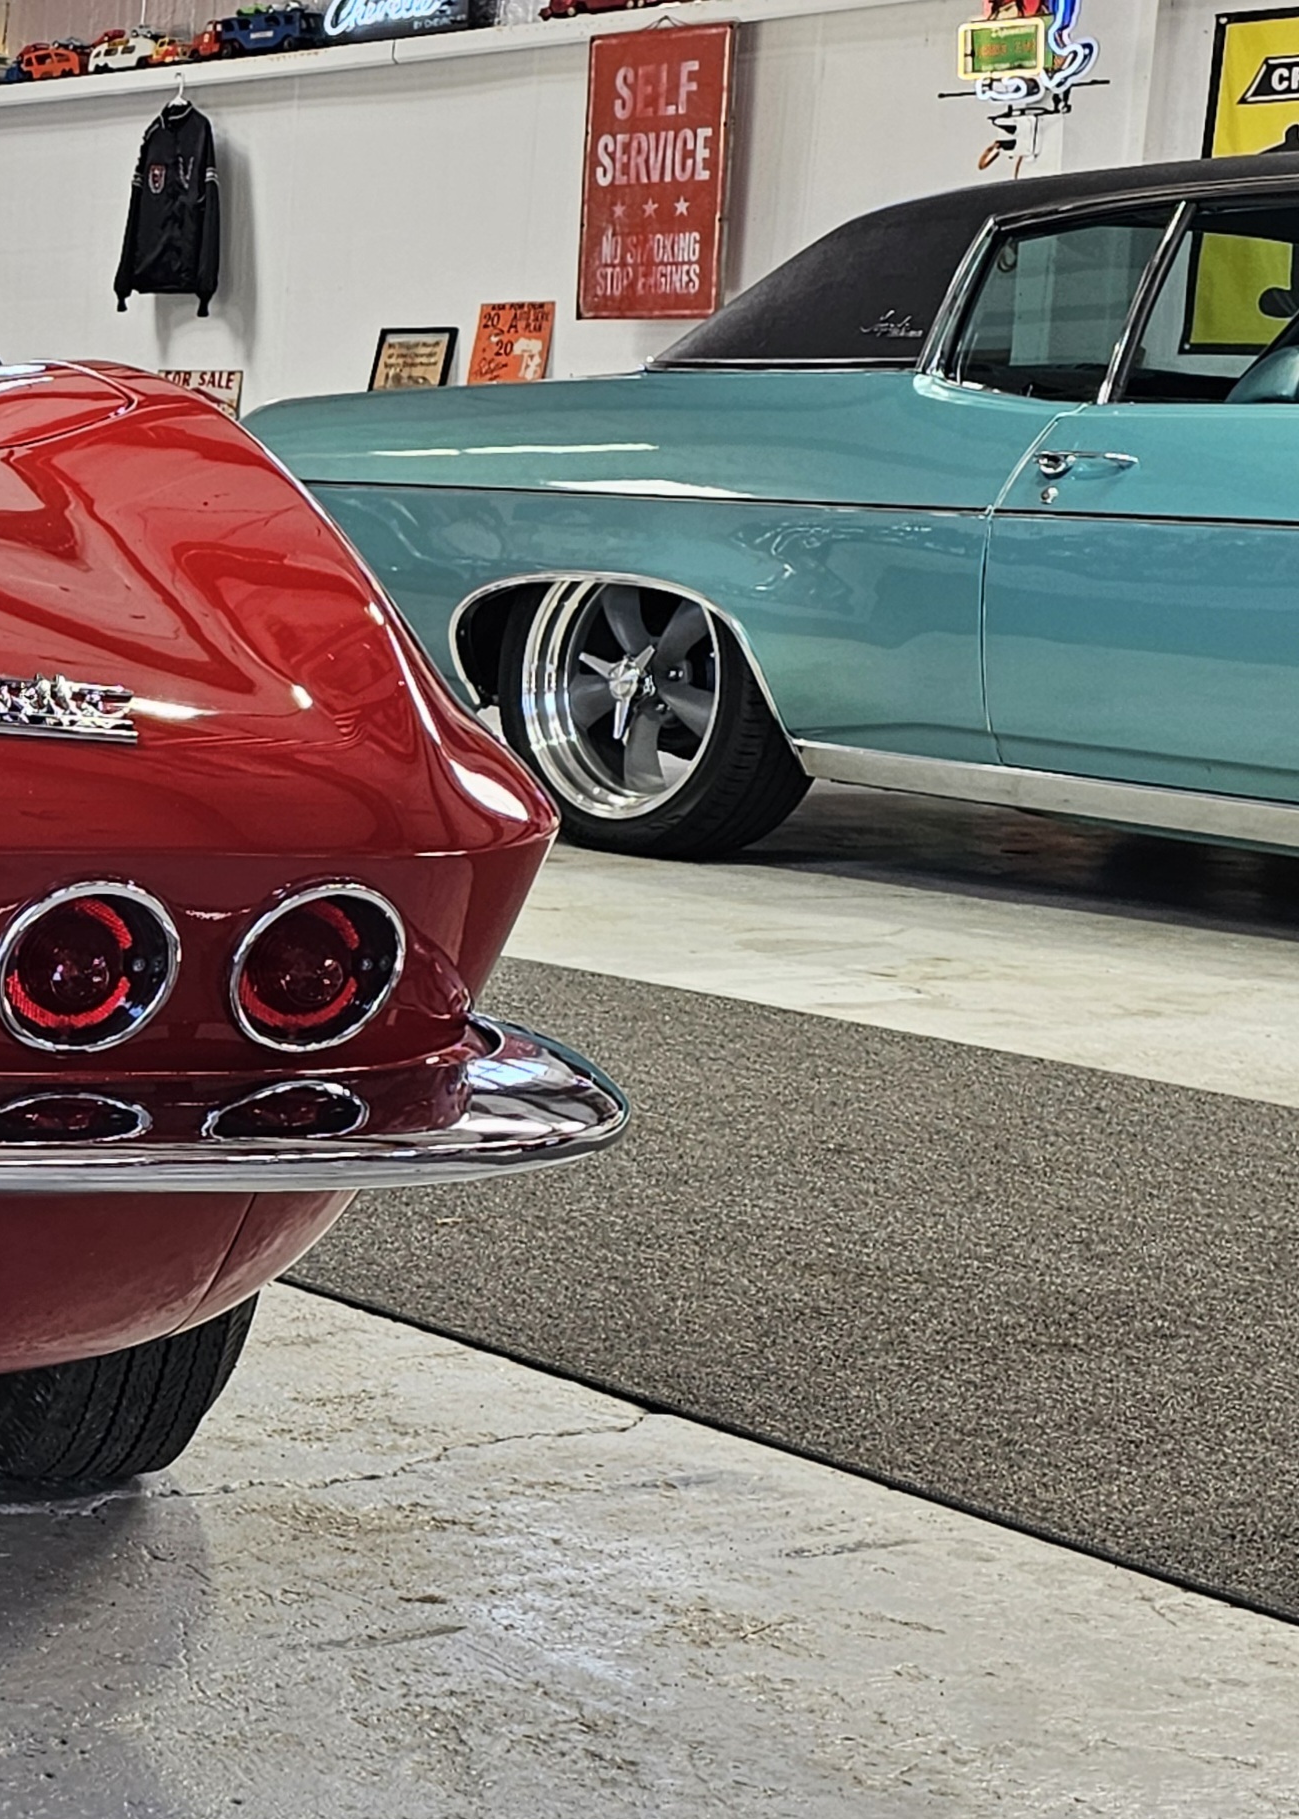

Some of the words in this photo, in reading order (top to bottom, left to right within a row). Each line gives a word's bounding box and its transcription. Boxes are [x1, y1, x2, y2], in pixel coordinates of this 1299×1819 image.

[614, 60, 700, 120] SELF
[596, 126, 713, 187] SERVICE
[601, 231, 621, 264] NO
[596, 266, 633, 296] STOP
[482, 312, 501, 329] 20
[494, 340, 515, 357] 20
[198, 371, 236, 390] SALE
